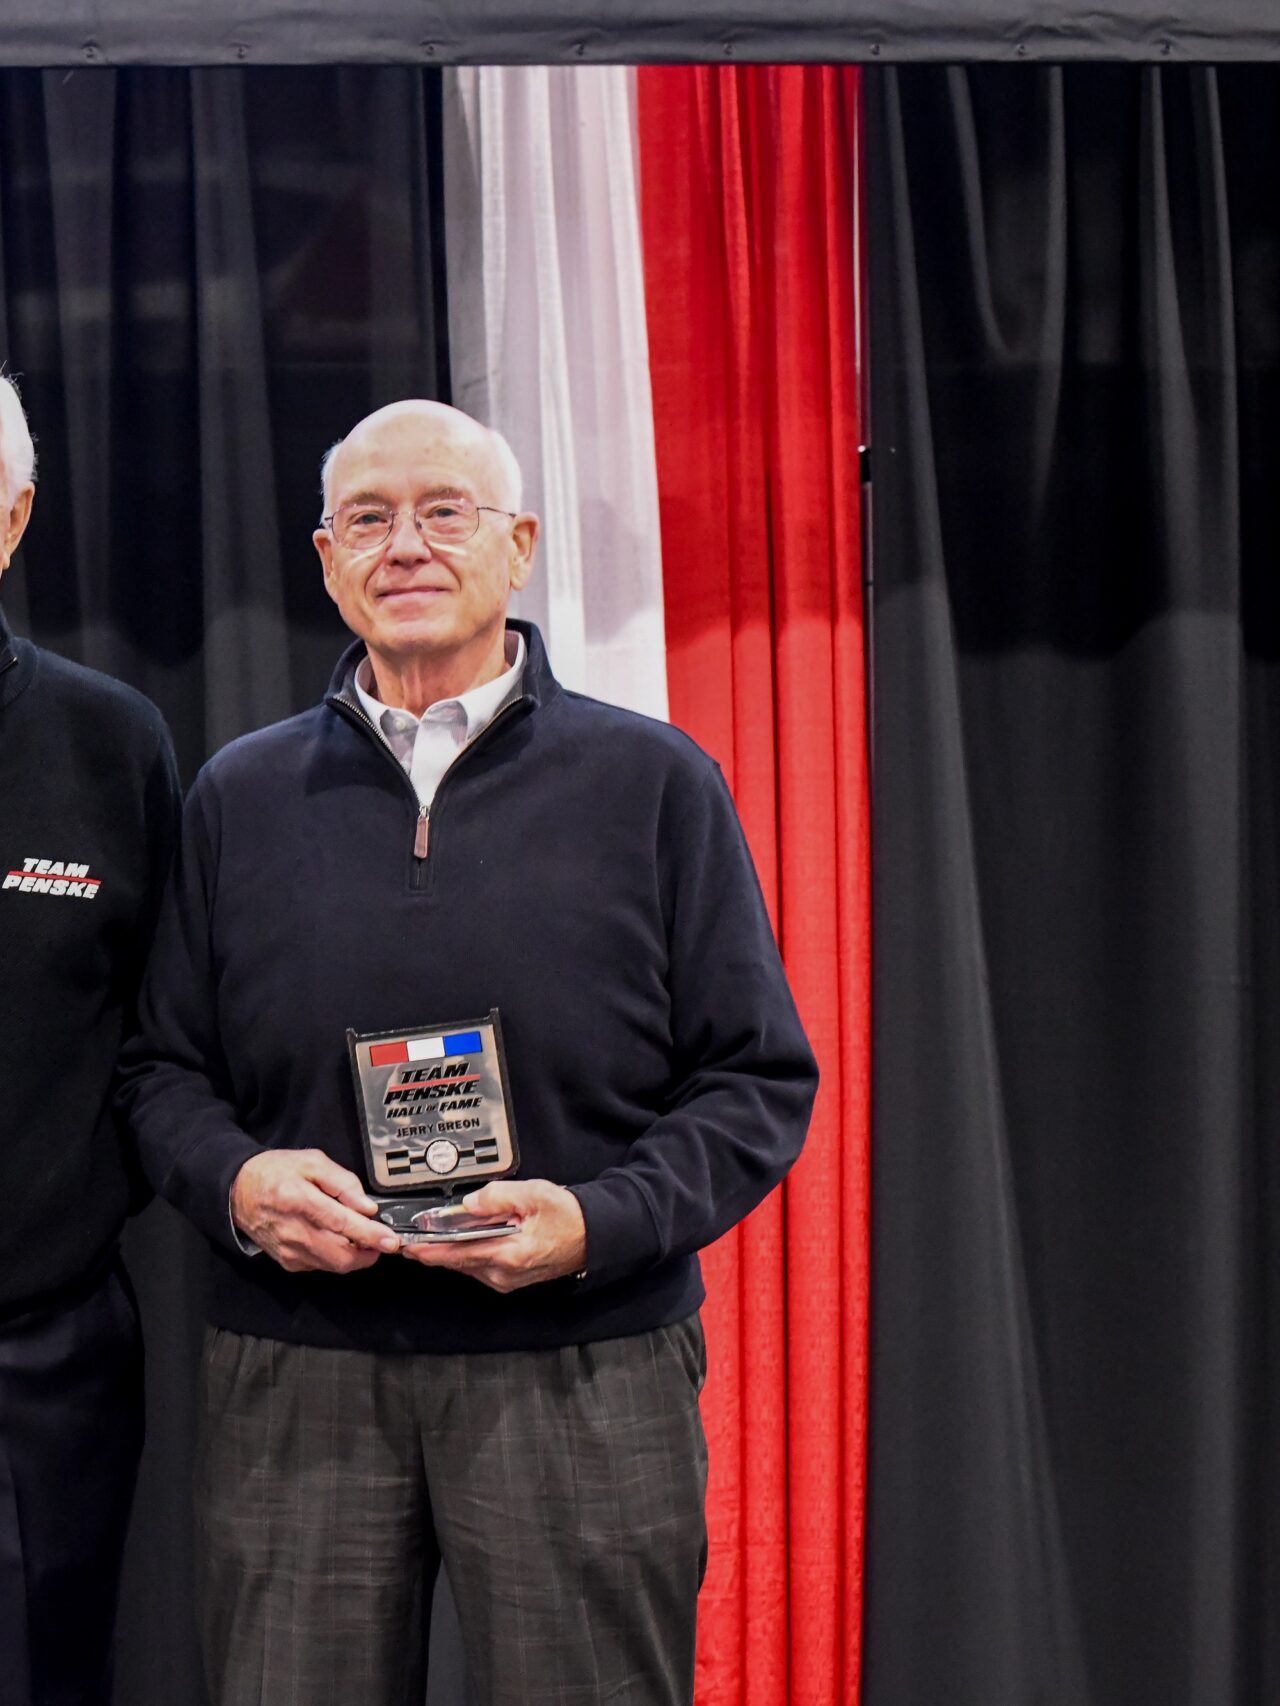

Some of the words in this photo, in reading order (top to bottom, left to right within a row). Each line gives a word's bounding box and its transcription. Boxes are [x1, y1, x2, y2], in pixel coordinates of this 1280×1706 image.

[22, 857, 90, 878] TEAM
[2, 874, 100, 899] PENSKE
[401, 1062, 470, 1084] TEAM
[384, 1080, 480, 1105] PENSKE
[386, 1105, 423, 1119] HALL
[439, 1097, 482, 1112] FAME
[396, 1123, 434, 1137] JERRY
[438, 1117, 480, 1132] BREON
